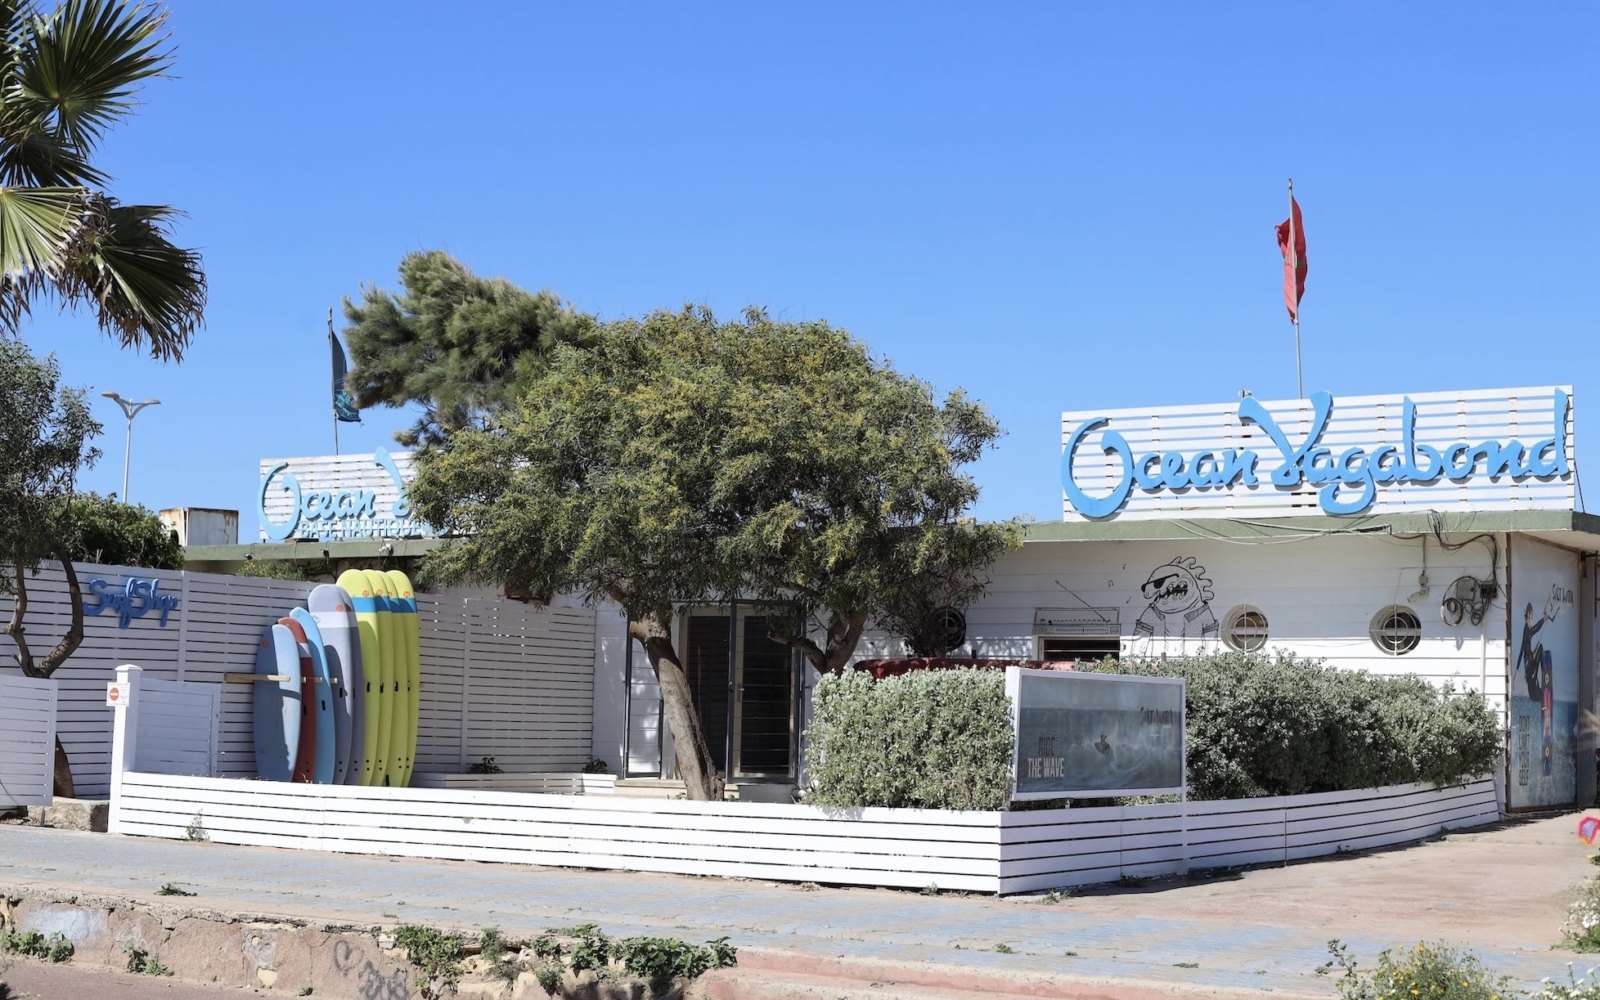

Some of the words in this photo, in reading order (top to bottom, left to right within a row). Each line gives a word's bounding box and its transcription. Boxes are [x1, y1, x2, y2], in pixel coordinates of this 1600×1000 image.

[1061, 416, 1259, 519] Ocean
[1238, 387, 1570, 515] Vagabond
[257, 461, 377, 540] Ocean
[300, 519, 337, 538] BASE
[340, 517, 424, 538] NAUTIQUE
[1038, 736, 1056, 757] RIDE
[1027, 757, 1042, 778] THE
[1043, 757, 1065, 778] WAVE
